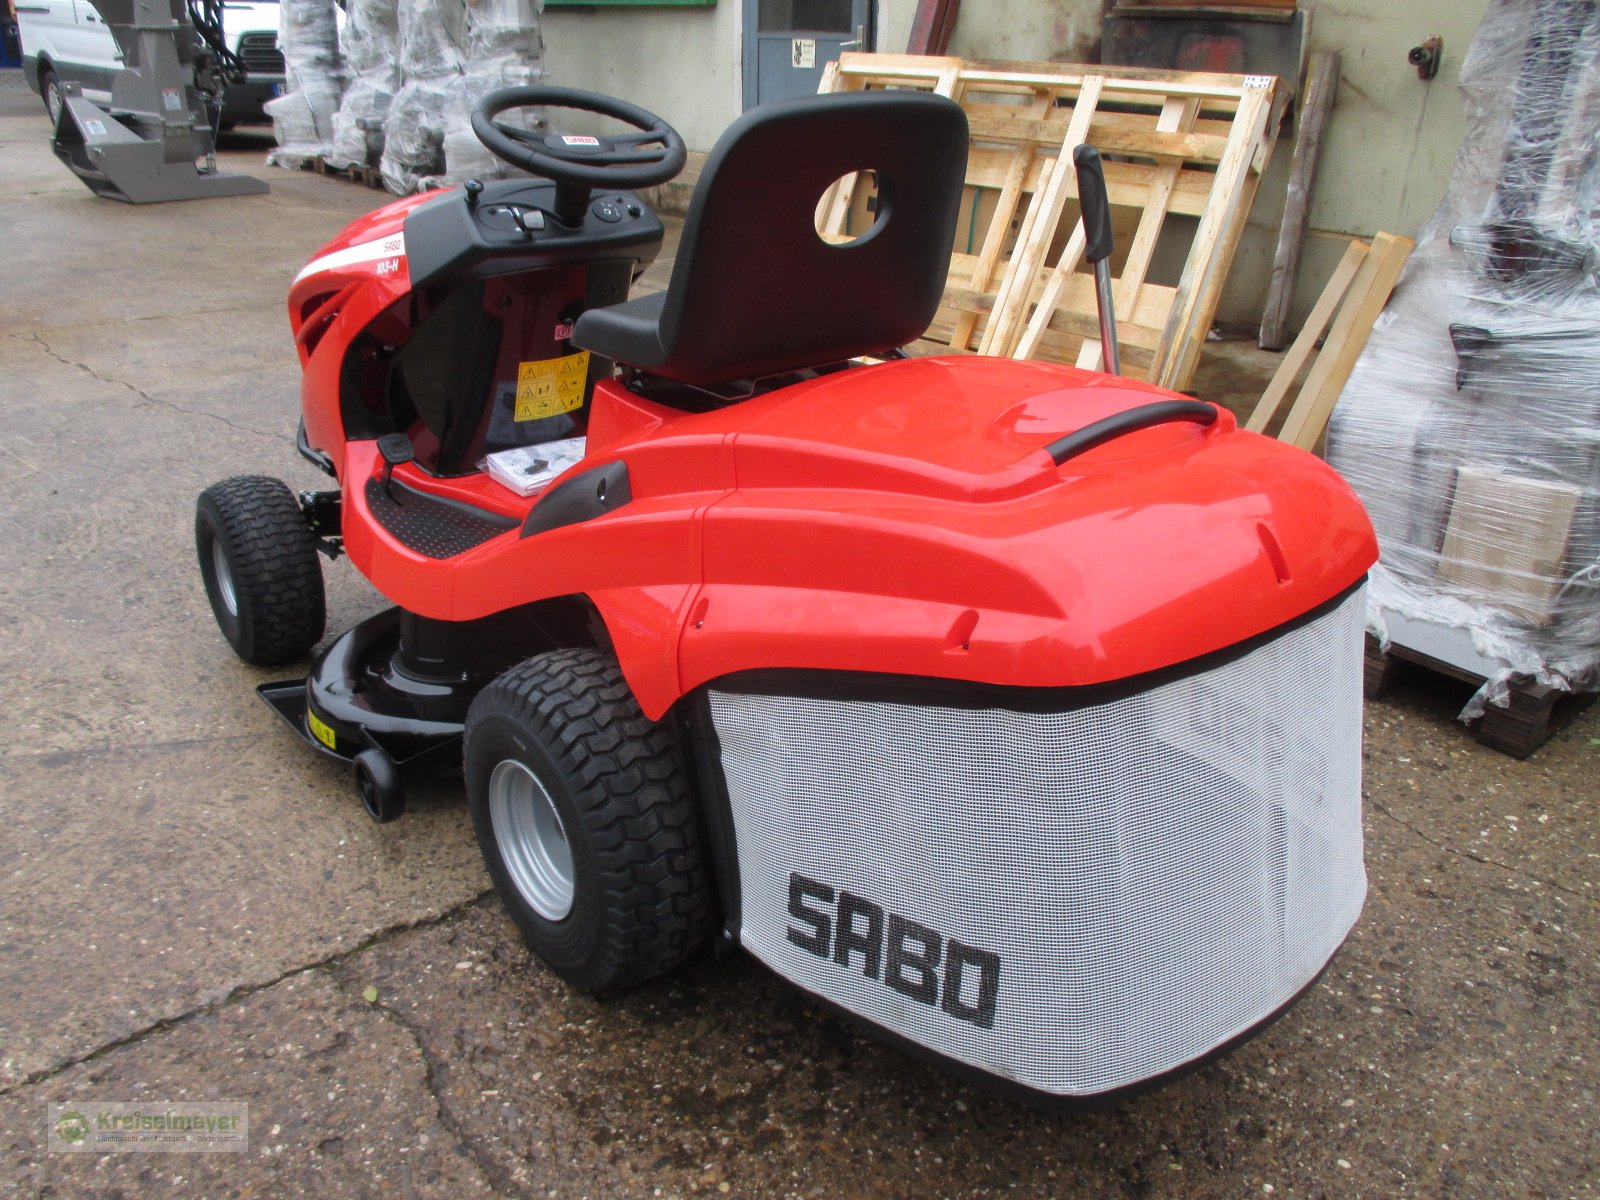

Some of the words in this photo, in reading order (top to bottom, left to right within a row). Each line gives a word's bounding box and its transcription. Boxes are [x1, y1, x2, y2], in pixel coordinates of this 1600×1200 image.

[565, 136, 597, 144] SABO
[384, 239, 402, 253] SABO
[376, 258, 399, 275] 103-H
[786, 871, 1001, 1030] SABO
